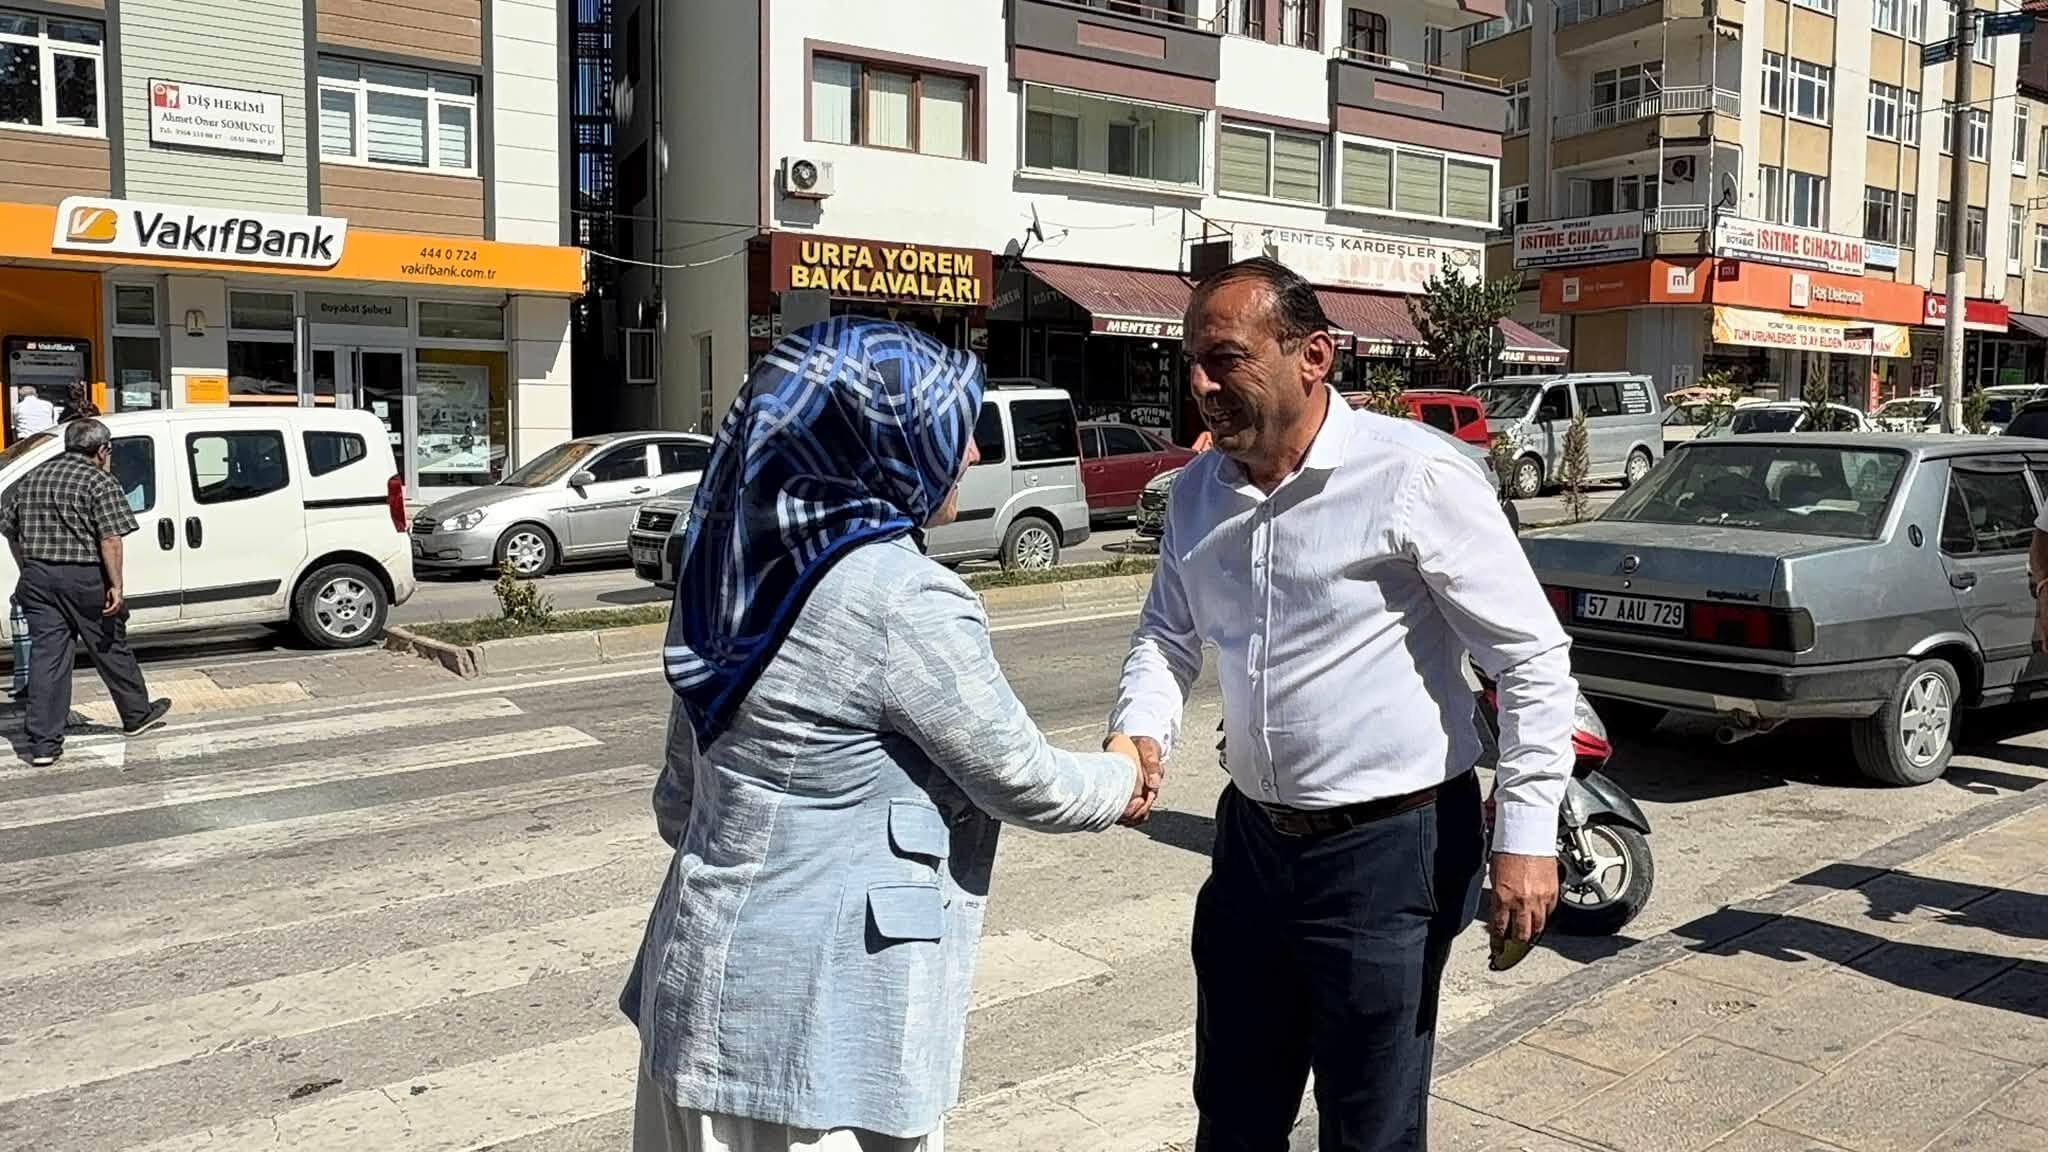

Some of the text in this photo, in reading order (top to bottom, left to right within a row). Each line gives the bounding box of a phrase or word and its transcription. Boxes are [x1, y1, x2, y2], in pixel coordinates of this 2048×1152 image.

[187, 94, 265, 114] DİŞ HEKİMİ
[162, 112, 193, 124] Ahmet
[221, 119, 275, 134] SOMUNCU
[133, 209, 335, 261] VakıfBank
[420, 247, 477, 261] 444 0 724
[801, 240, 973, 276] URFA YÖREM
[1340, 238, 1437, 259] KARDEŞLER
[401, 263, 496, 280] vakifbank.com.tr
[791, 265, 981, 299] BAKLAVALARI
[1166, 325, 1184, 337] KA
[1588, 597, 1682, 625] 57 AAU 729
